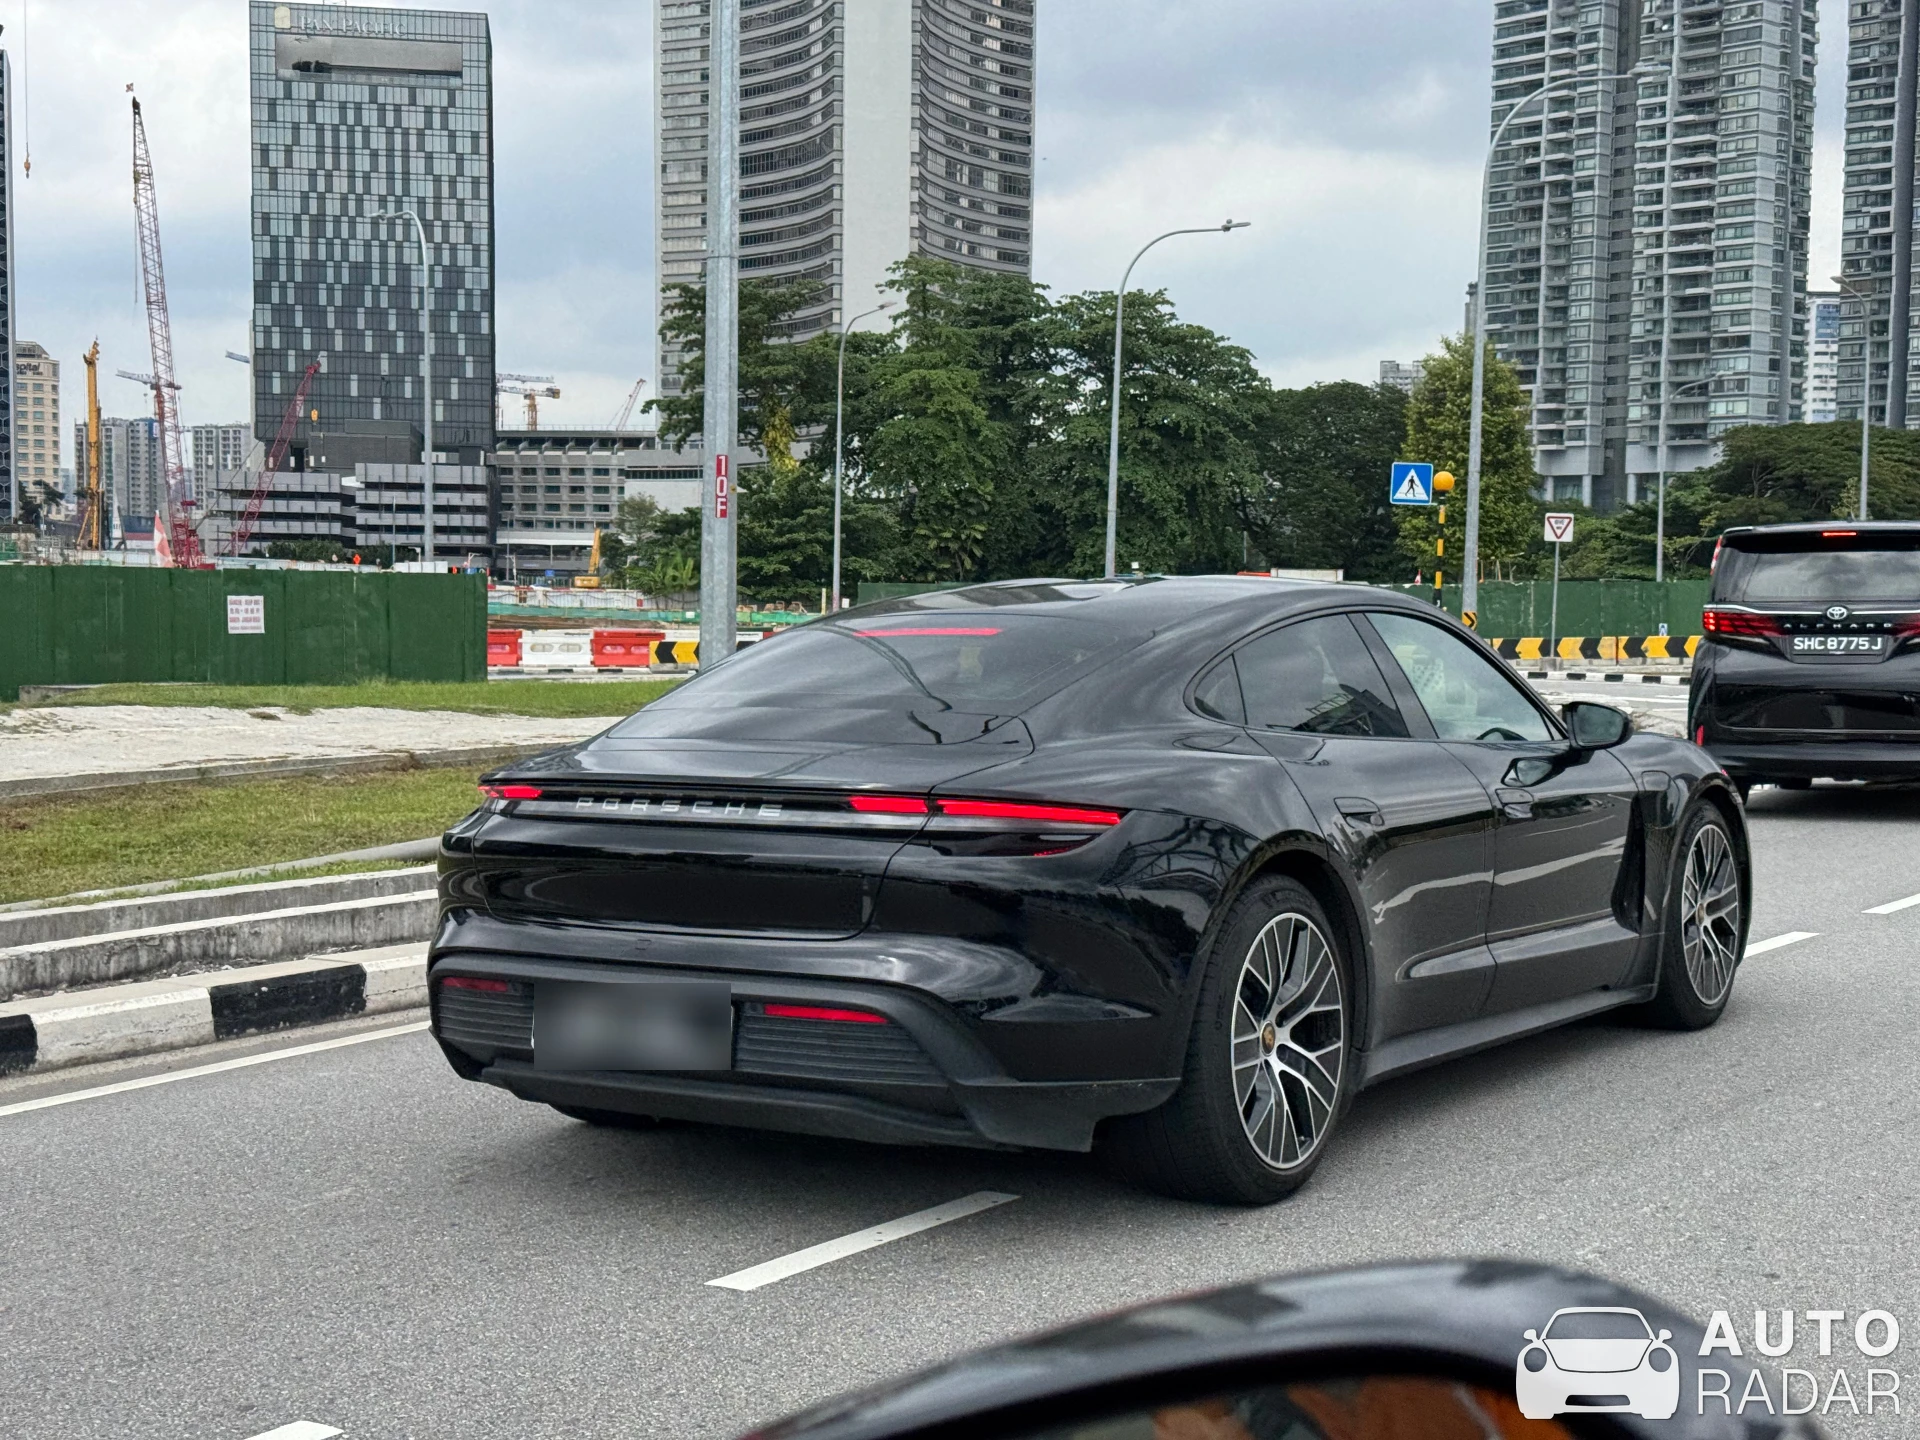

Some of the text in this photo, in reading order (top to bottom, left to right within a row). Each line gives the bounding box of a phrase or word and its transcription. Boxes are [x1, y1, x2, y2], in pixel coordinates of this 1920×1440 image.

[301, 15, 406, 36] PAN PACIFIC
[717, 455, 727, 518] 10F
[576, 797, 783, 817] PORSCHE
